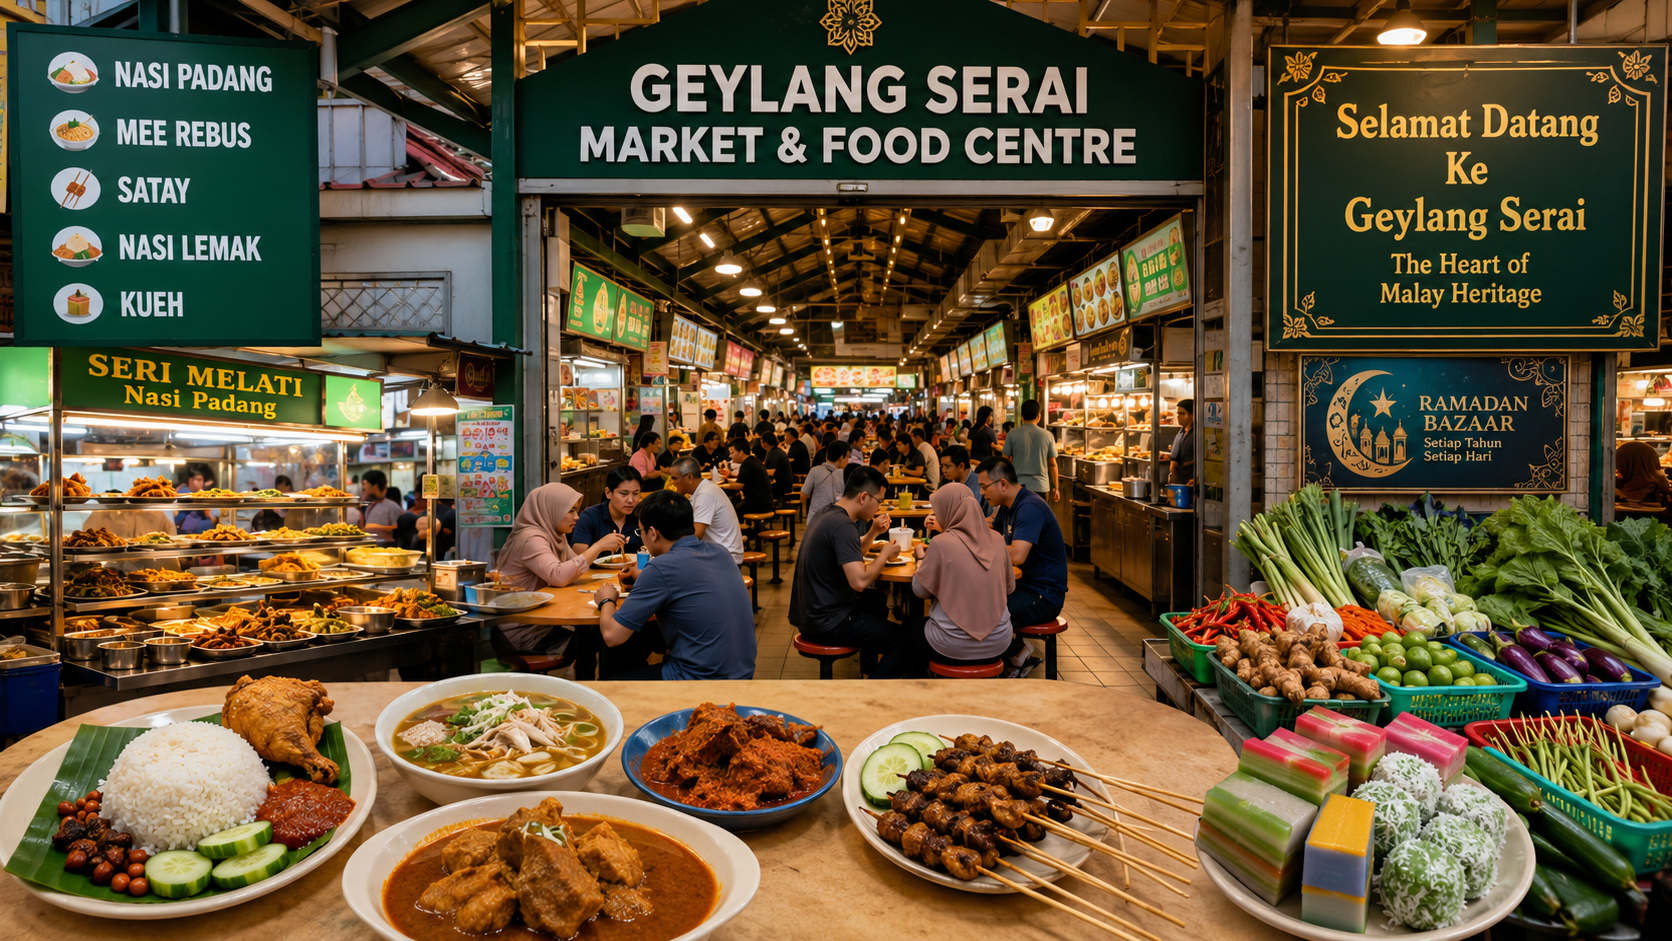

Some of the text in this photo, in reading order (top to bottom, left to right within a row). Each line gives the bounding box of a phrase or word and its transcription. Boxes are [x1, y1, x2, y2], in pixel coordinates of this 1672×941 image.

[115, 61, 272, 92] NASI PADANG
[631, 64, 1088, 114] GEYLANG SERAI
[117, 119, 251, 148] MEE REBUS
[1336, 103, 1599, 147] Selamat Datang
[580, 126, 1137, 165] MARKET & FOOD CENTRE
[1445, 152, 1489, 185] Ke
[118, 176, 190, 204] SATAY
[1345, 197, 1587, 240] Geylang Serai
[119, 234, 261, 261] NASI LEMAK
[1391, 252, 1530, 275] The Heart of
[121, 292, 184, 318] KUEH
[1380, 283, 1542, 309] Malay Heritage
[88, 353, 303, 397] SERI MELATI
[124, 385, 277, 420] Nasi Padang
[1419, 395, 1529, 412] RAMADAN
[1424, 415, 1516, 432] BAZAAR
[1424, 437, 1502, 451] Setiap Tahun
[1424, 450, 1492, 464] Setiap Hari
